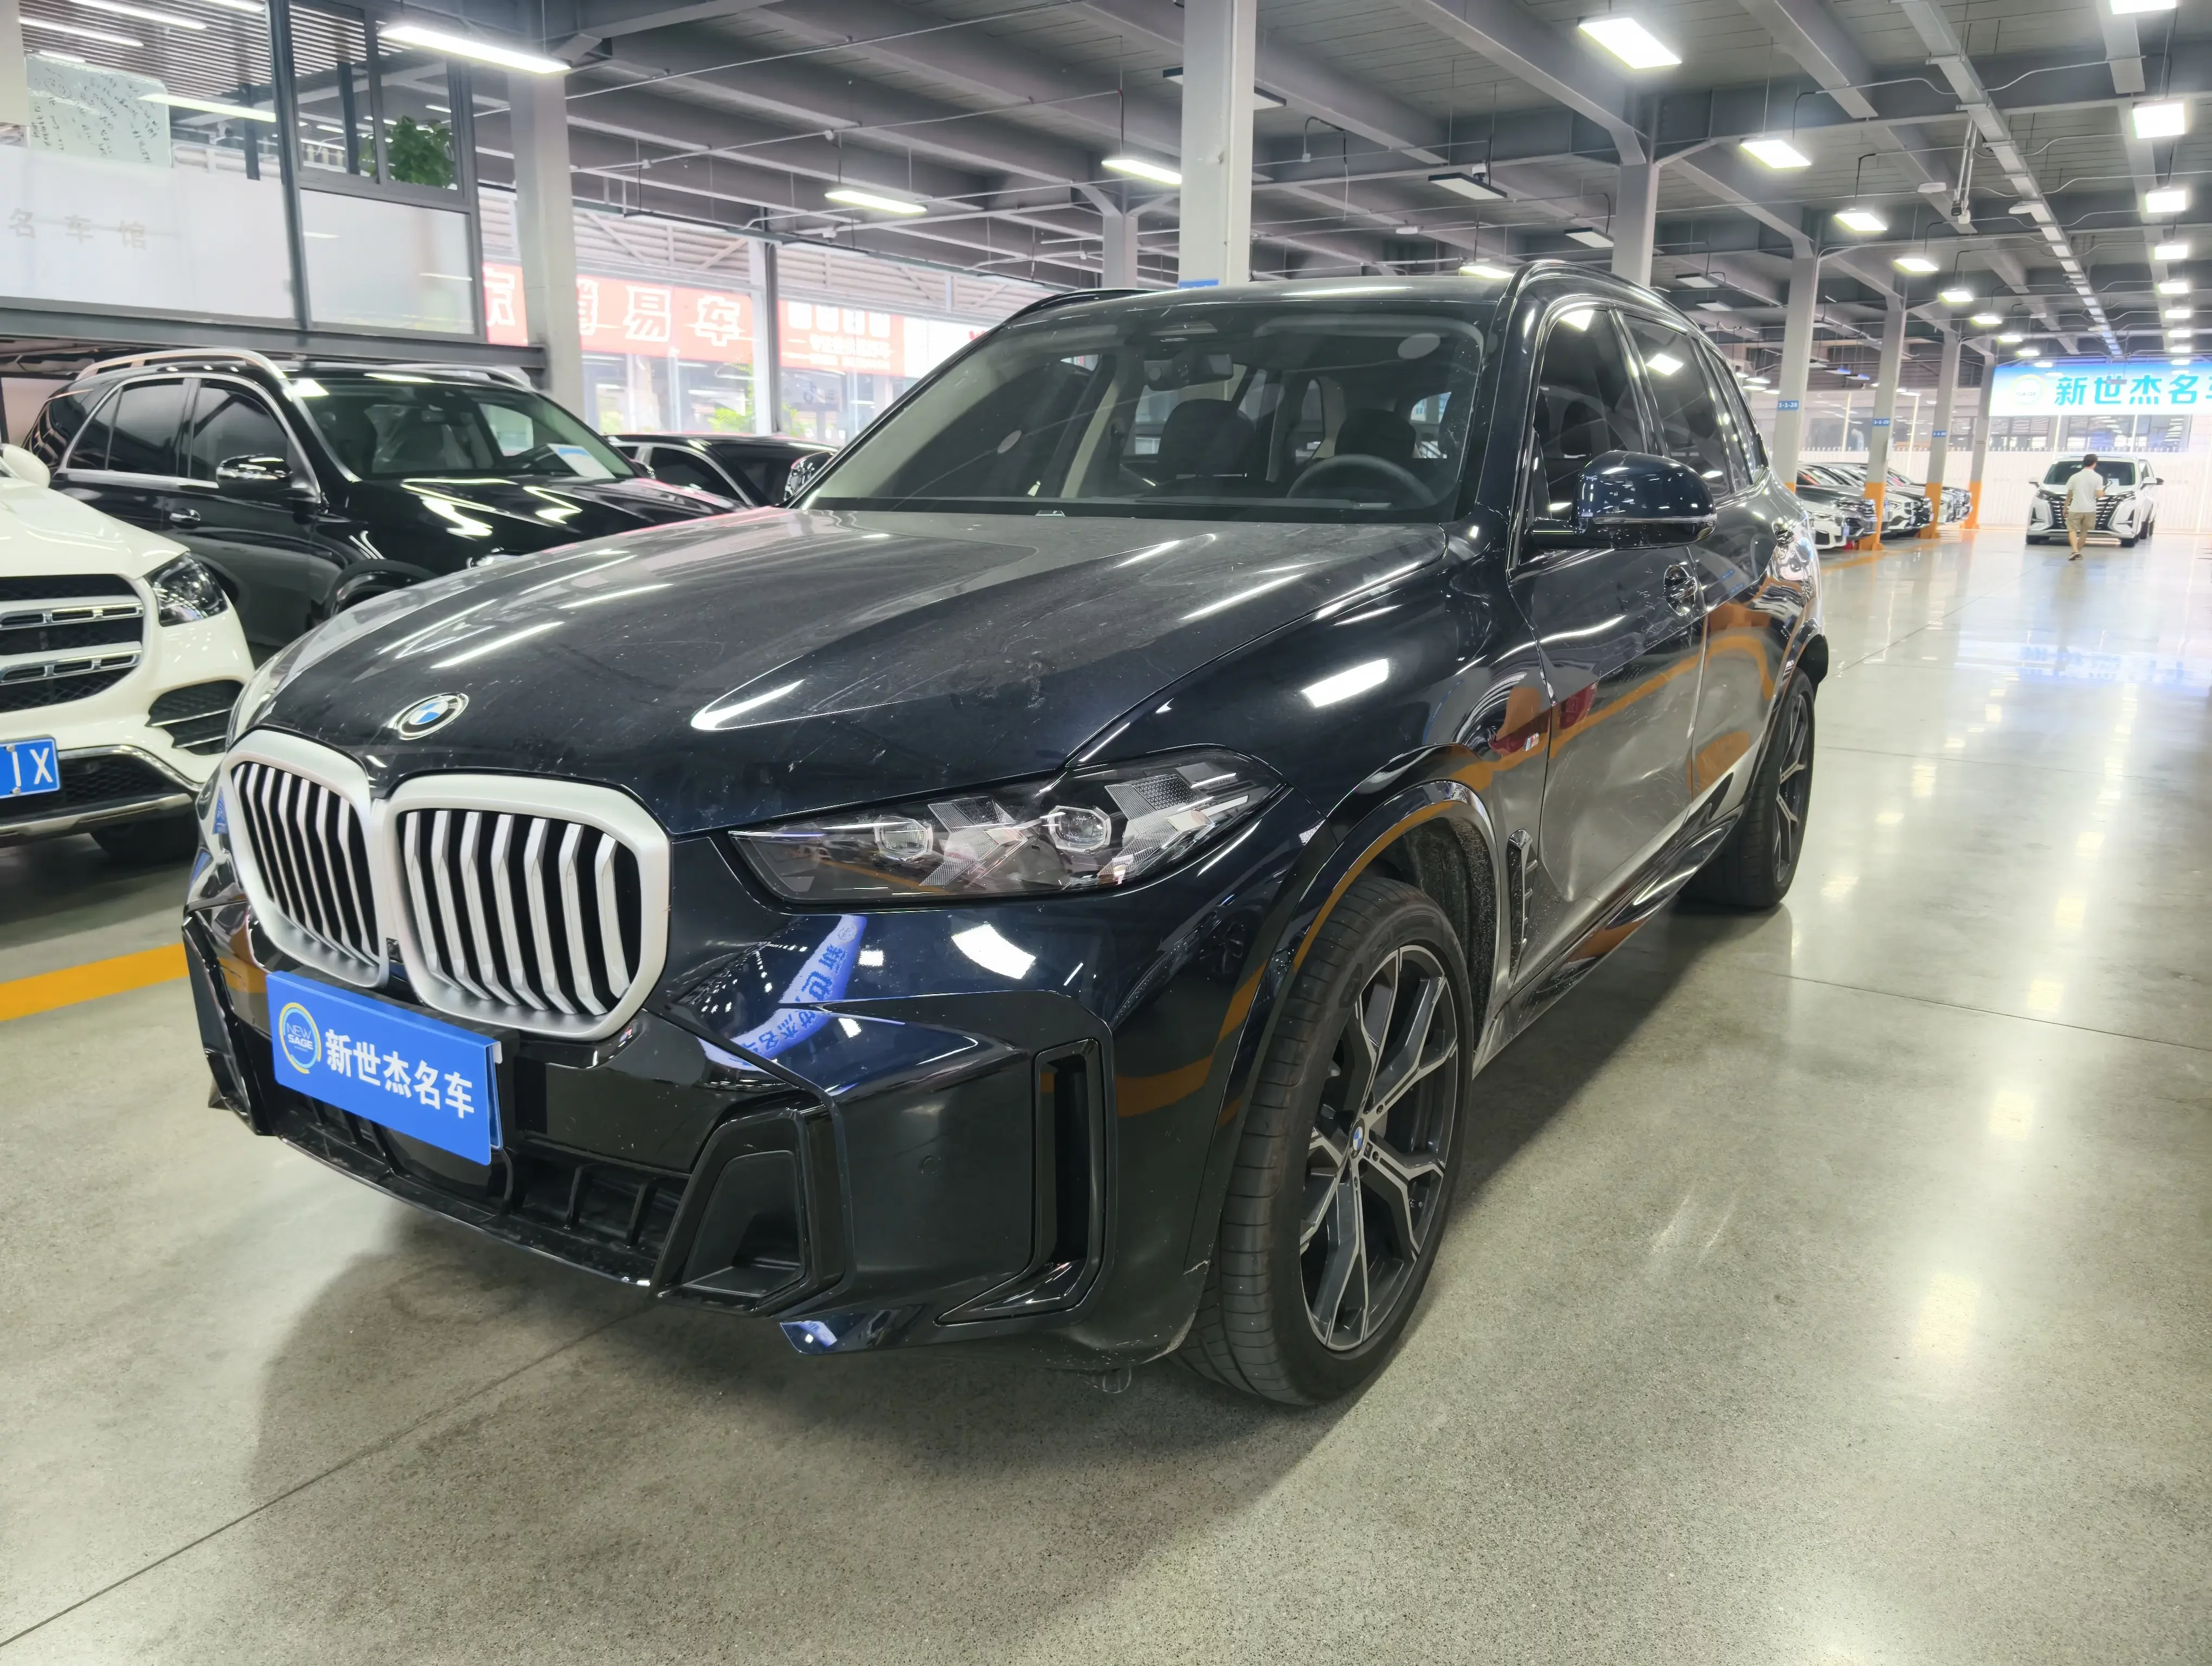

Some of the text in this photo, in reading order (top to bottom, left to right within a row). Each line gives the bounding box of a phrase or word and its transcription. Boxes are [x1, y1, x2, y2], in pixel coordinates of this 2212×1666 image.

[8, 207, 147, 251] 名车馆
[2054, 374, 2212, 405] 新世杰名
[286, 1022, 312, 1040] NEW
[287, 1034, 314, 1050] SAGE
[325, 1028, 475, 1119] 新世杰名车
